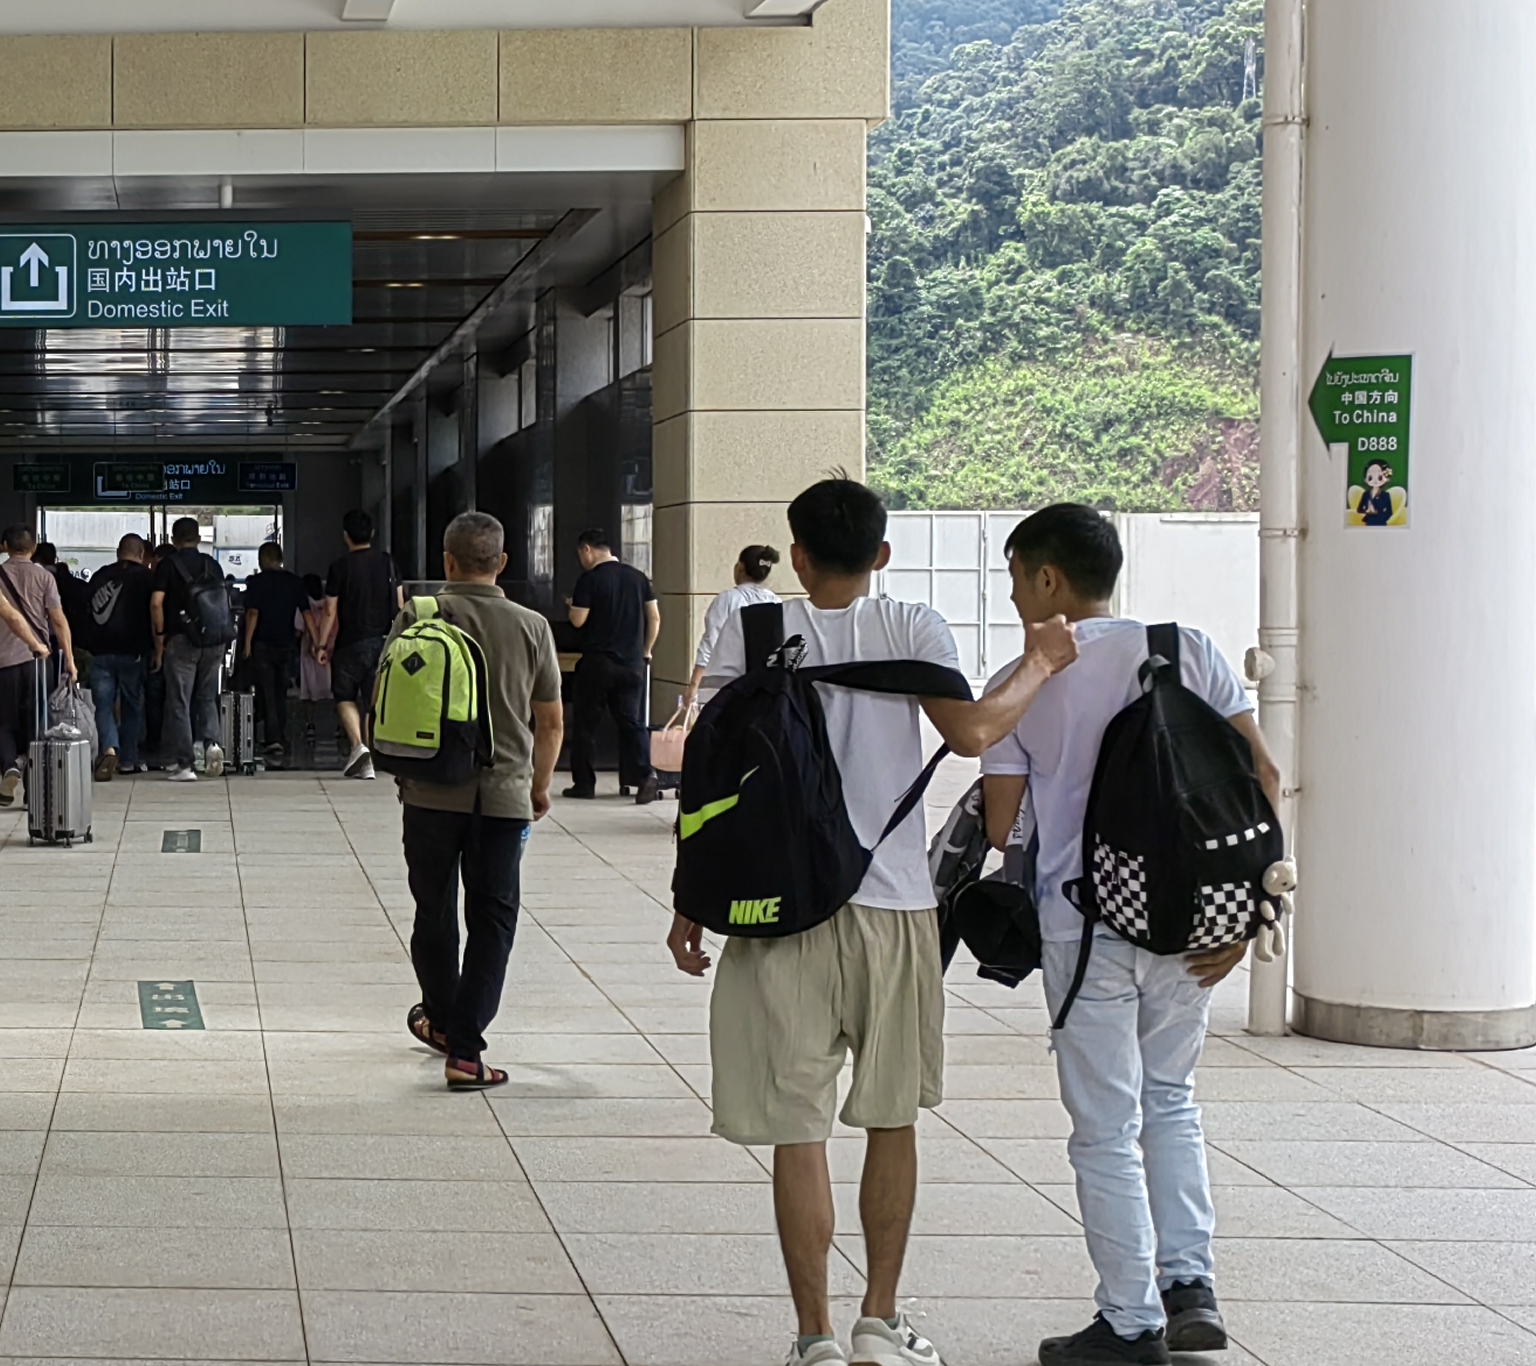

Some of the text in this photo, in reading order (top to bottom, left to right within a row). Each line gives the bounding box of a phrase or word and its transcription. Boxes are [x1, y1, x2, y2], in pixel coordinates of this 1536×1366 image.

[87, 230, 278, 265] ທາງອອກພາຍໃນ
[87, 266, 216, 293] 国内出站口
[87, 298, 229, 318] Domestic Exit
[1341, 390, 1399, 405] 中国方向
[1333, 409, 1398, 425] To China
[1357, 436, 1398, 452] D888
[169, 492, 184, 501] Exit
[728, 896, 782, 925] NIKE
